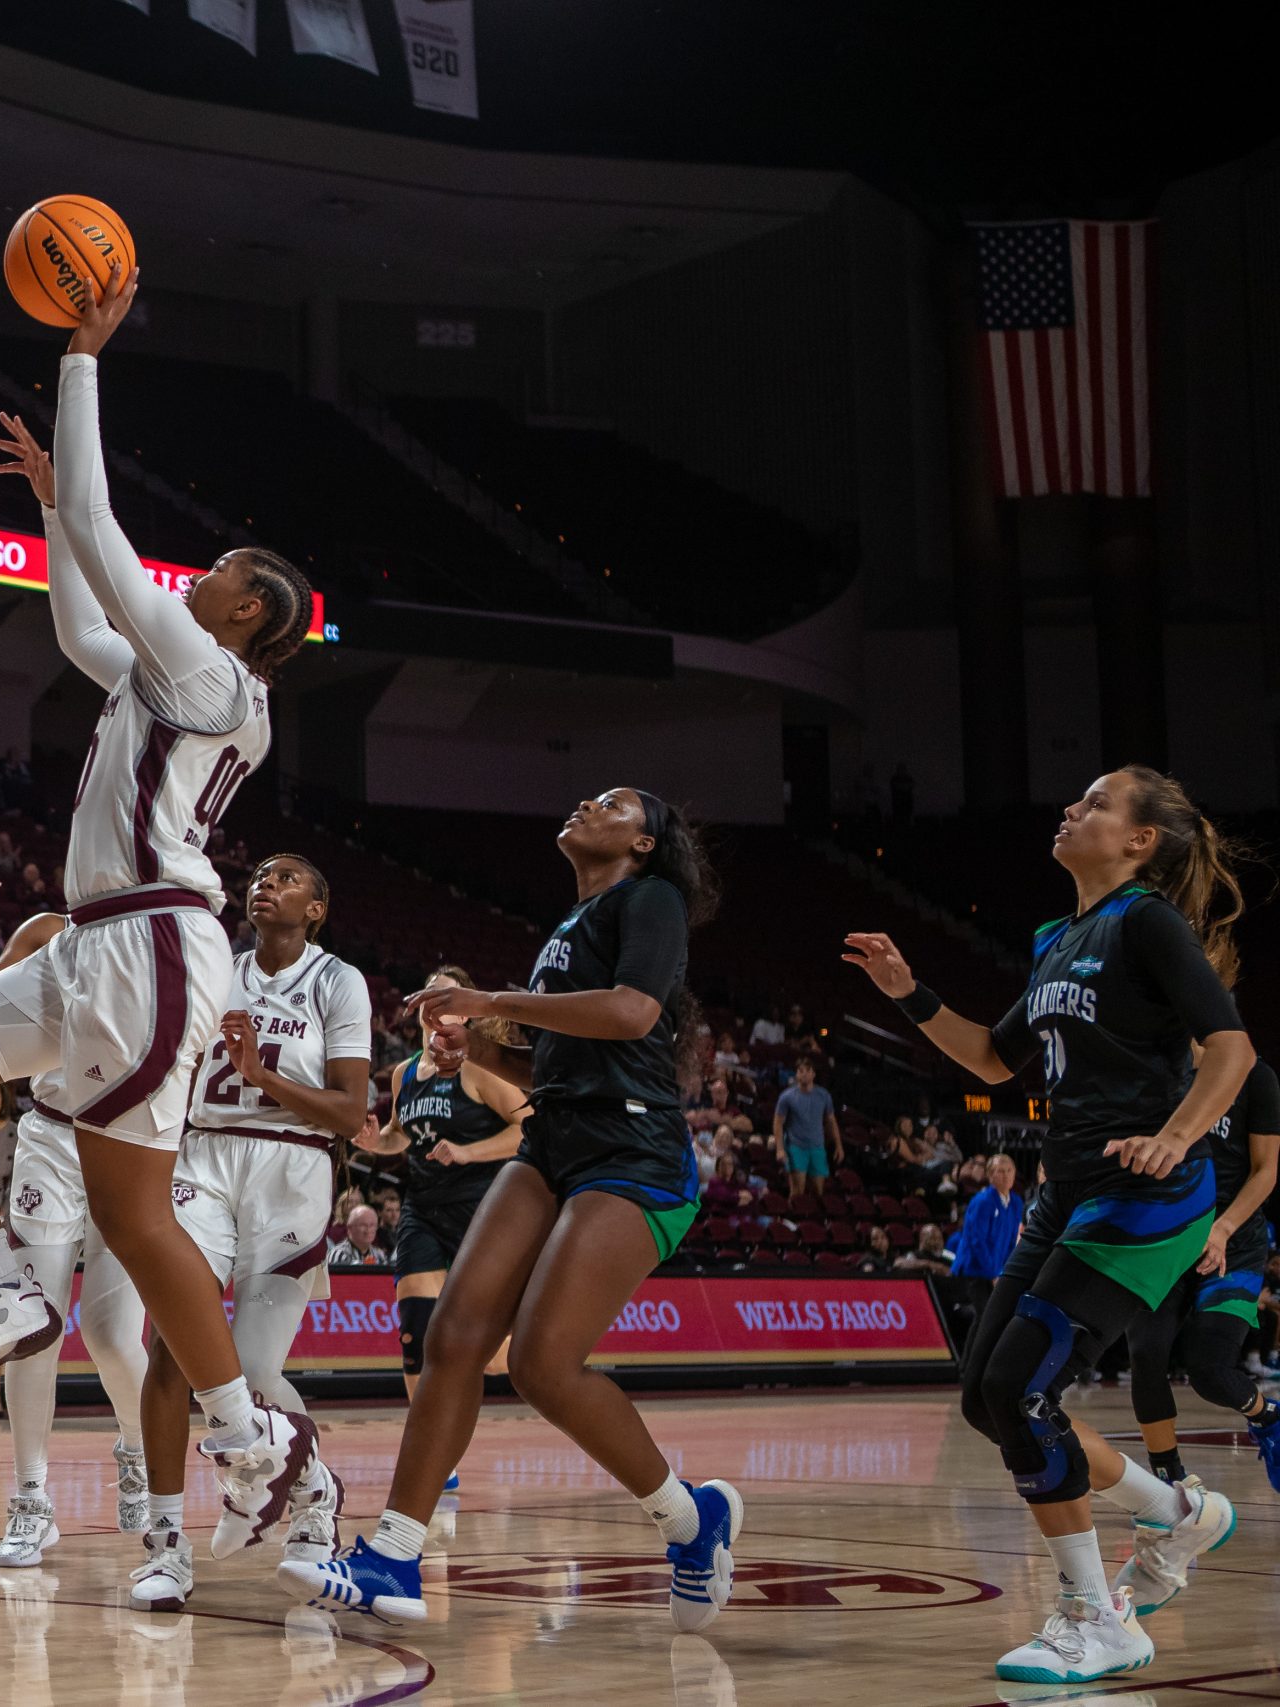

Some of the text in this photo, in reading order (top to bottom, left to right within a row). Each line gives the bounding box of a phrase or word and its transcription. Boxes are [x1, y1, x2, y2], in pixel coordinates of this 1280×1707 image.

[412, 41, 459, 77] 920
[1027, 981, 1097, 1026] LANDERS
[267, 1017, 308, 1039] A&M
[399, 1096, 452, 1125] SLANDERS
[607, 1300, 680, 1332] ARGO
[735, 1300, 907, 1331] WELLS FARGO
